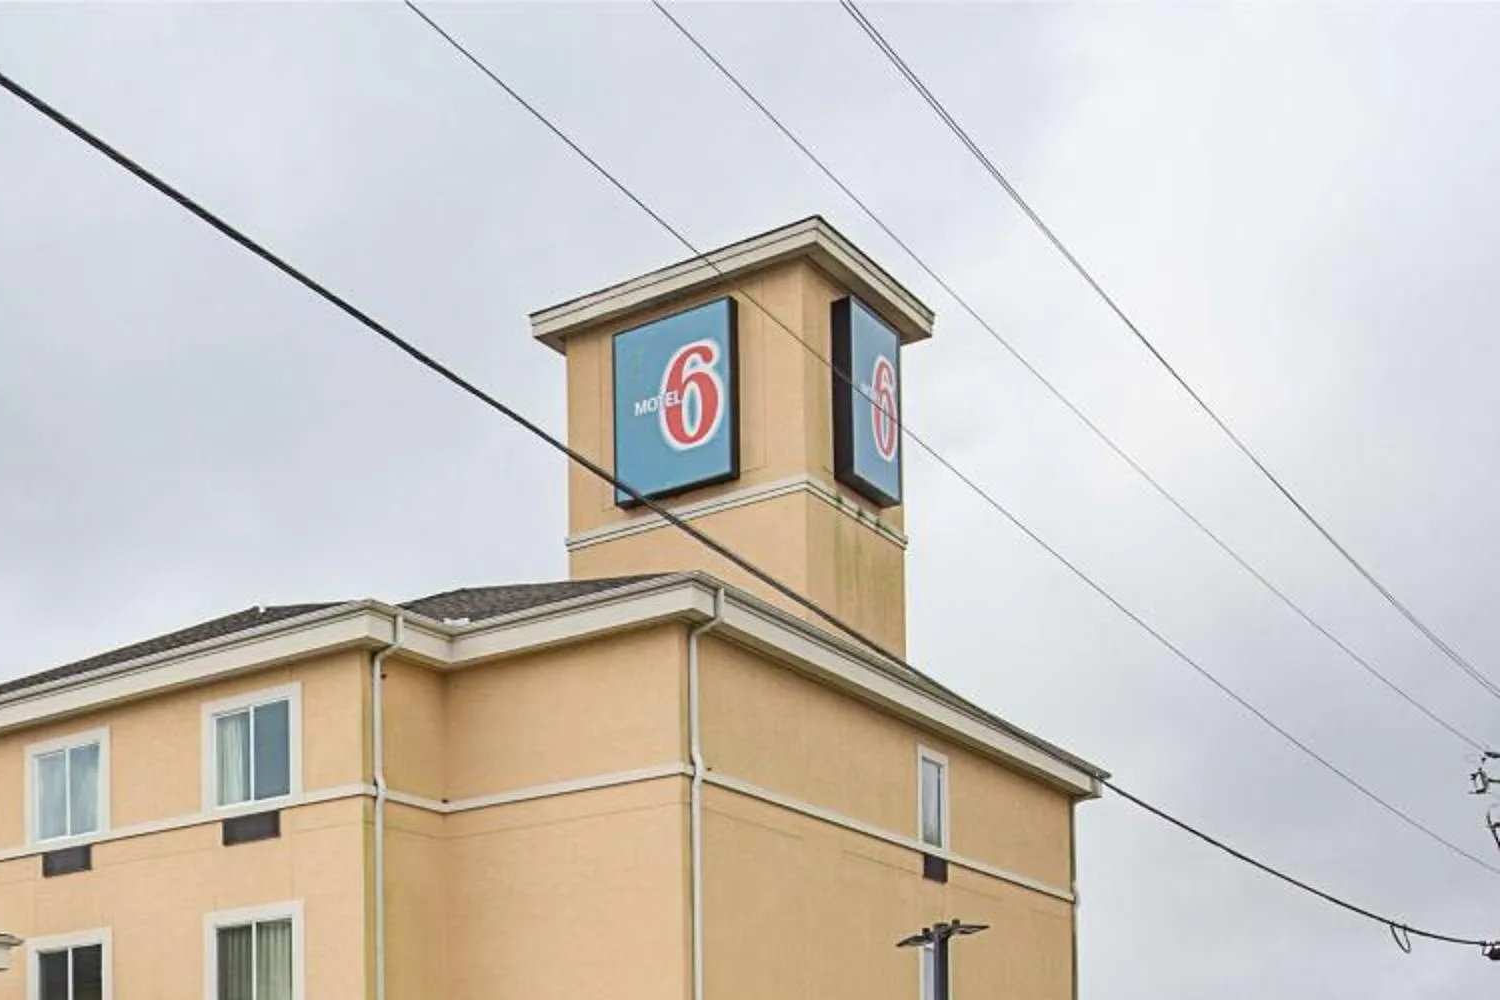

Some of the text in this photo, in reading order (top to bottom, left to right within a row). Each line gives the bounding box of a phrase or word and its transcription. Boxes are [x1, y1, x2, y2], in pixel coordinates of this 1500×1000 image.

[634, 337, 724, 450] MOTEL 6
[871, 355, 897, 462] 6
